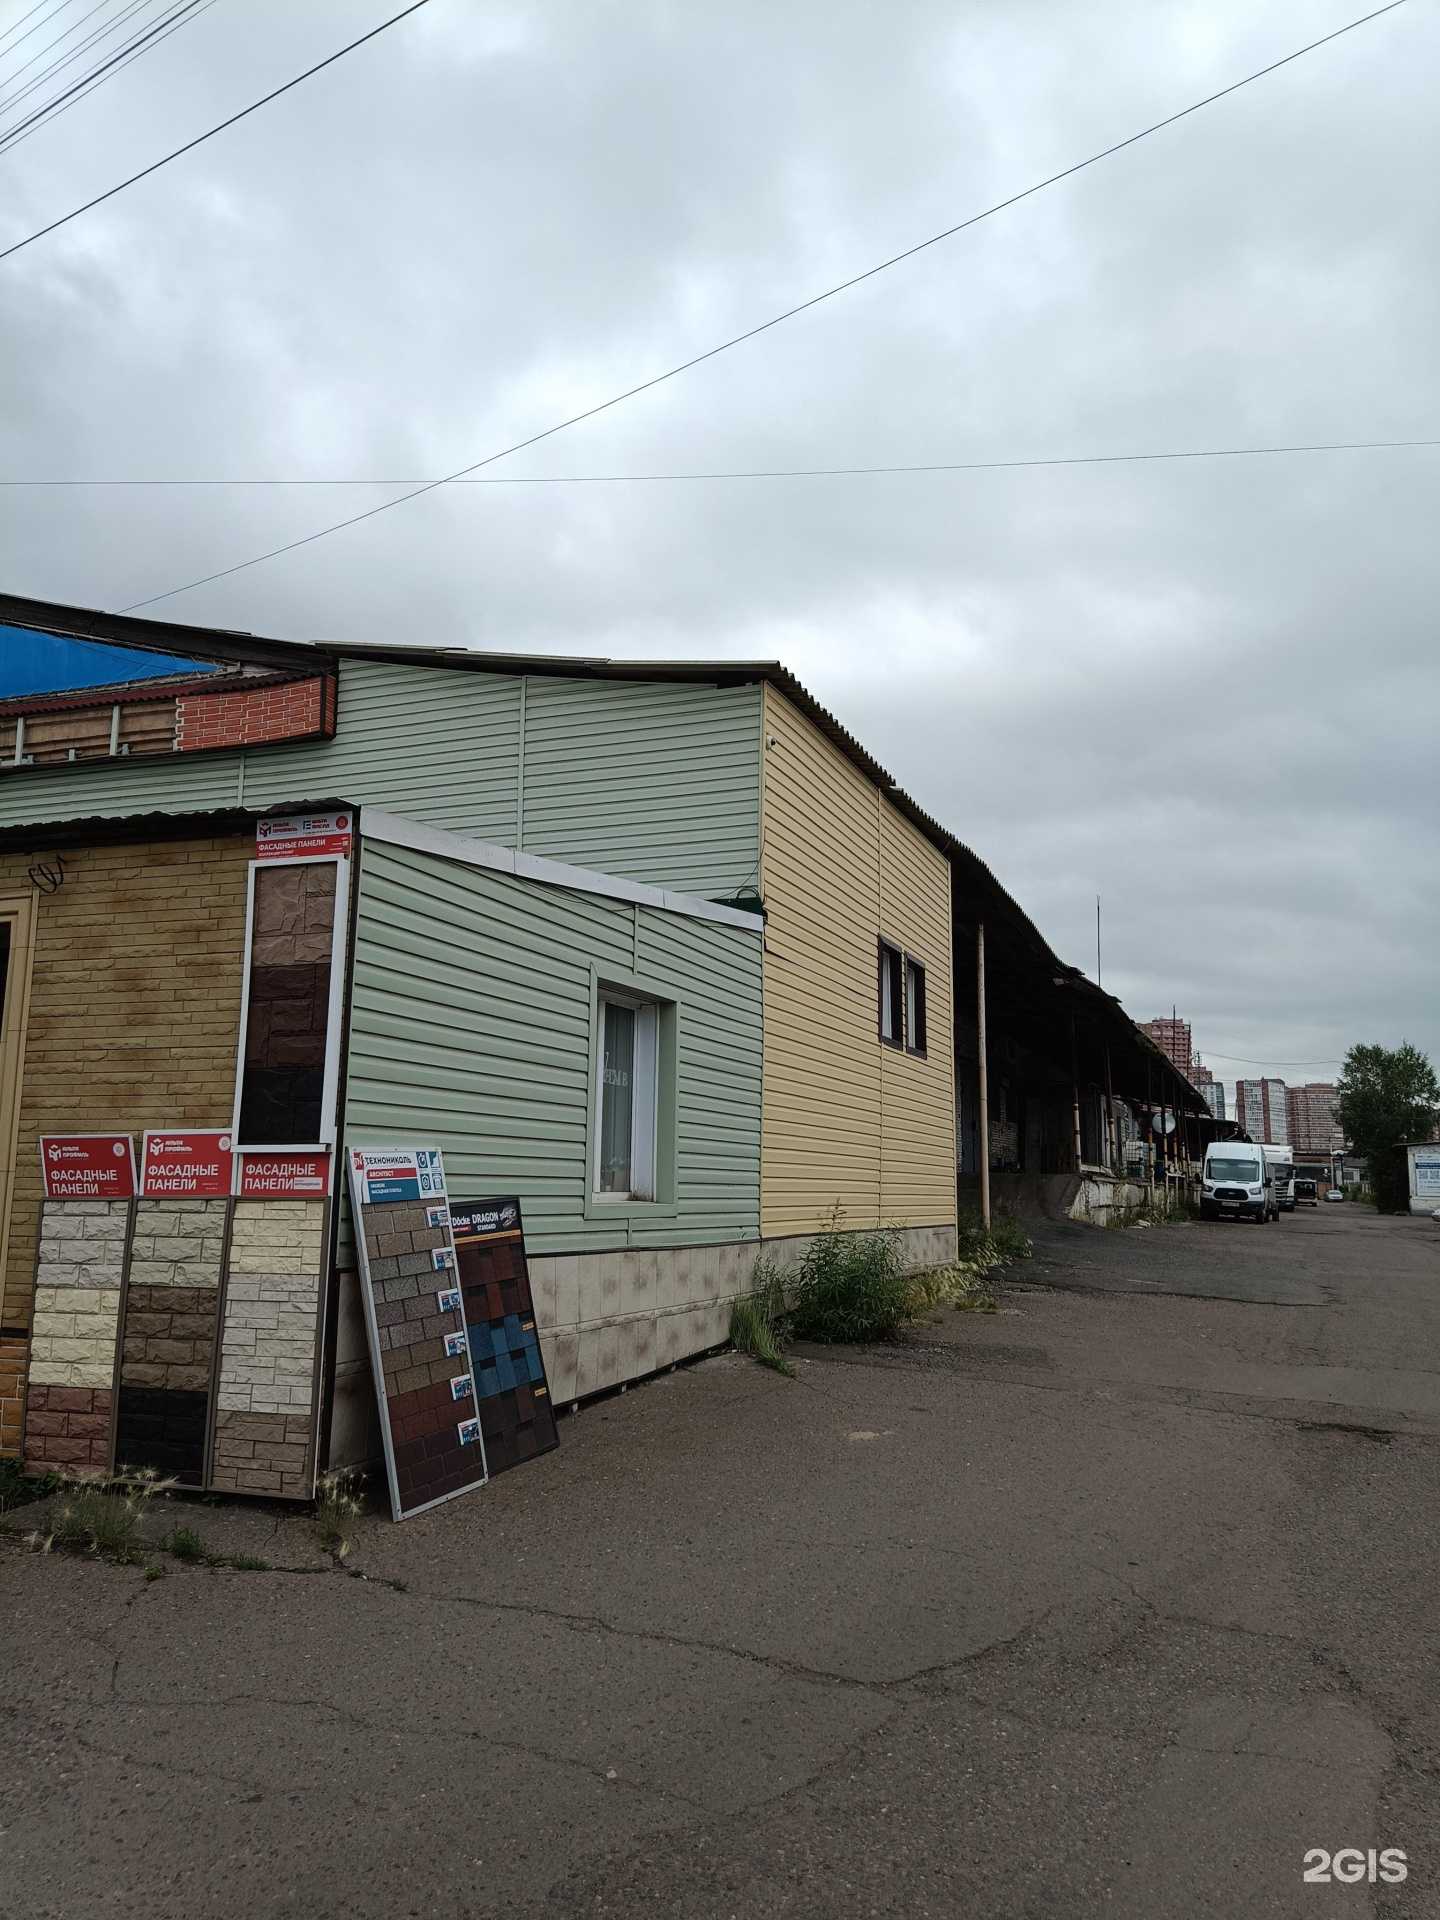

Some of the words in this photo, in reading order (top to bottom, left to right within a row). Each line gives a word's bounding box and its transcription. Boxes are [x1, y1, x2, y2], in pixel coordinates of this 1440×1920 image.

[259, 841, 297, 851] ФАСАДНЫЕ
[298, 839, 326, 847] ПАНЕЛИ
[364, 1156, 412, 1165] ТЕХНОНИКОЛЬ
[51, 1169, 118, 1182] ФАСАДНЫЕ
[148, 1164, 219, 1177] ФАСАДНЫЕ
[246, 1163, 316, 1177] ФАСАДНЫЕ
[52, 1183, 99, 1194] ПАНЕЛИ
[147, 1178, 197, 1190] ПАНЕЛИ
[245, 1177, 295, 1190] ПАНЕЛИ
[472, 1212, 499, 1224] DRAGON
